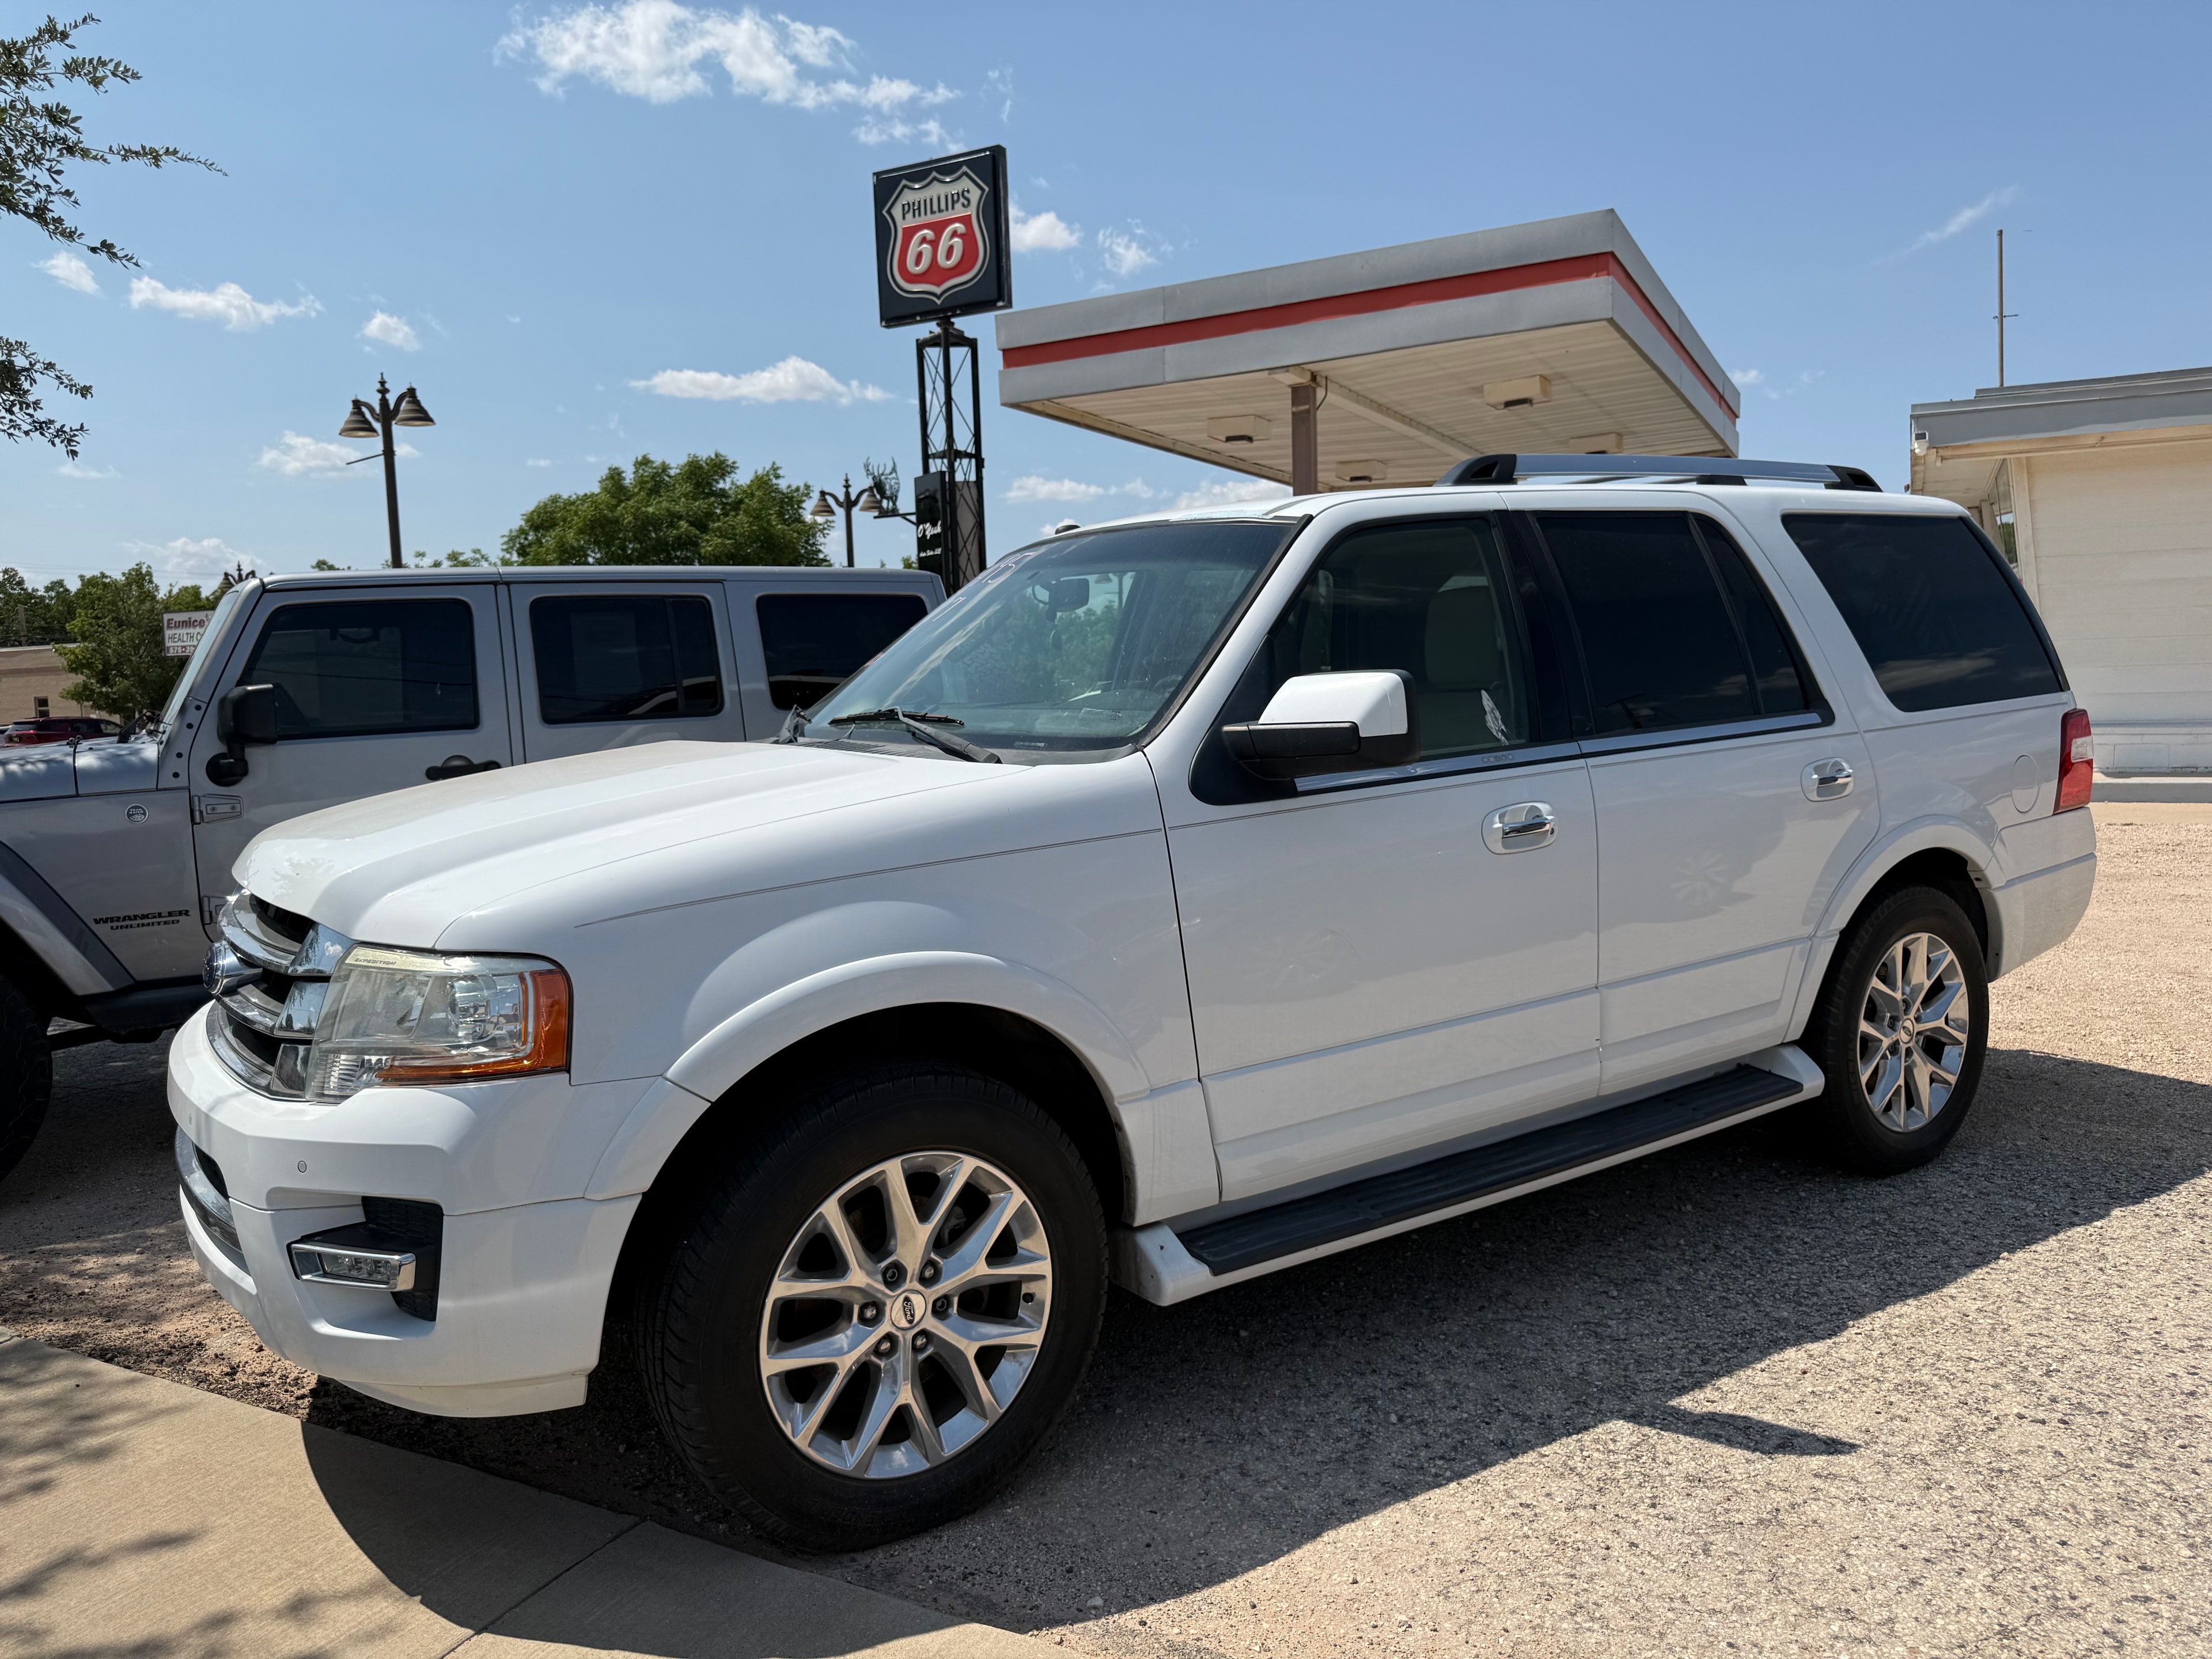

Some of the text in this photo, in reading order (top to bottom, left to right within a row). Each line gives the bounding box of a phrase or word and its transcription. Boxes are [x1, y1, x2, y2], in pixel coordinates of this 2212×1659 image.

[902, 187, 971, 220] PHILLIPS
[906, 222, 966, 275] 66
[166, 617, 206, 630] Eunice
[168, 632, 195, 643] HEALTH
[93, 910, 190, 925] WRANGLER
[110, 919, 180, 930] UNLIMITED
[355, 957, 397, 965] EXPEDITION
[904, 1301, 914, 1320] Ford
